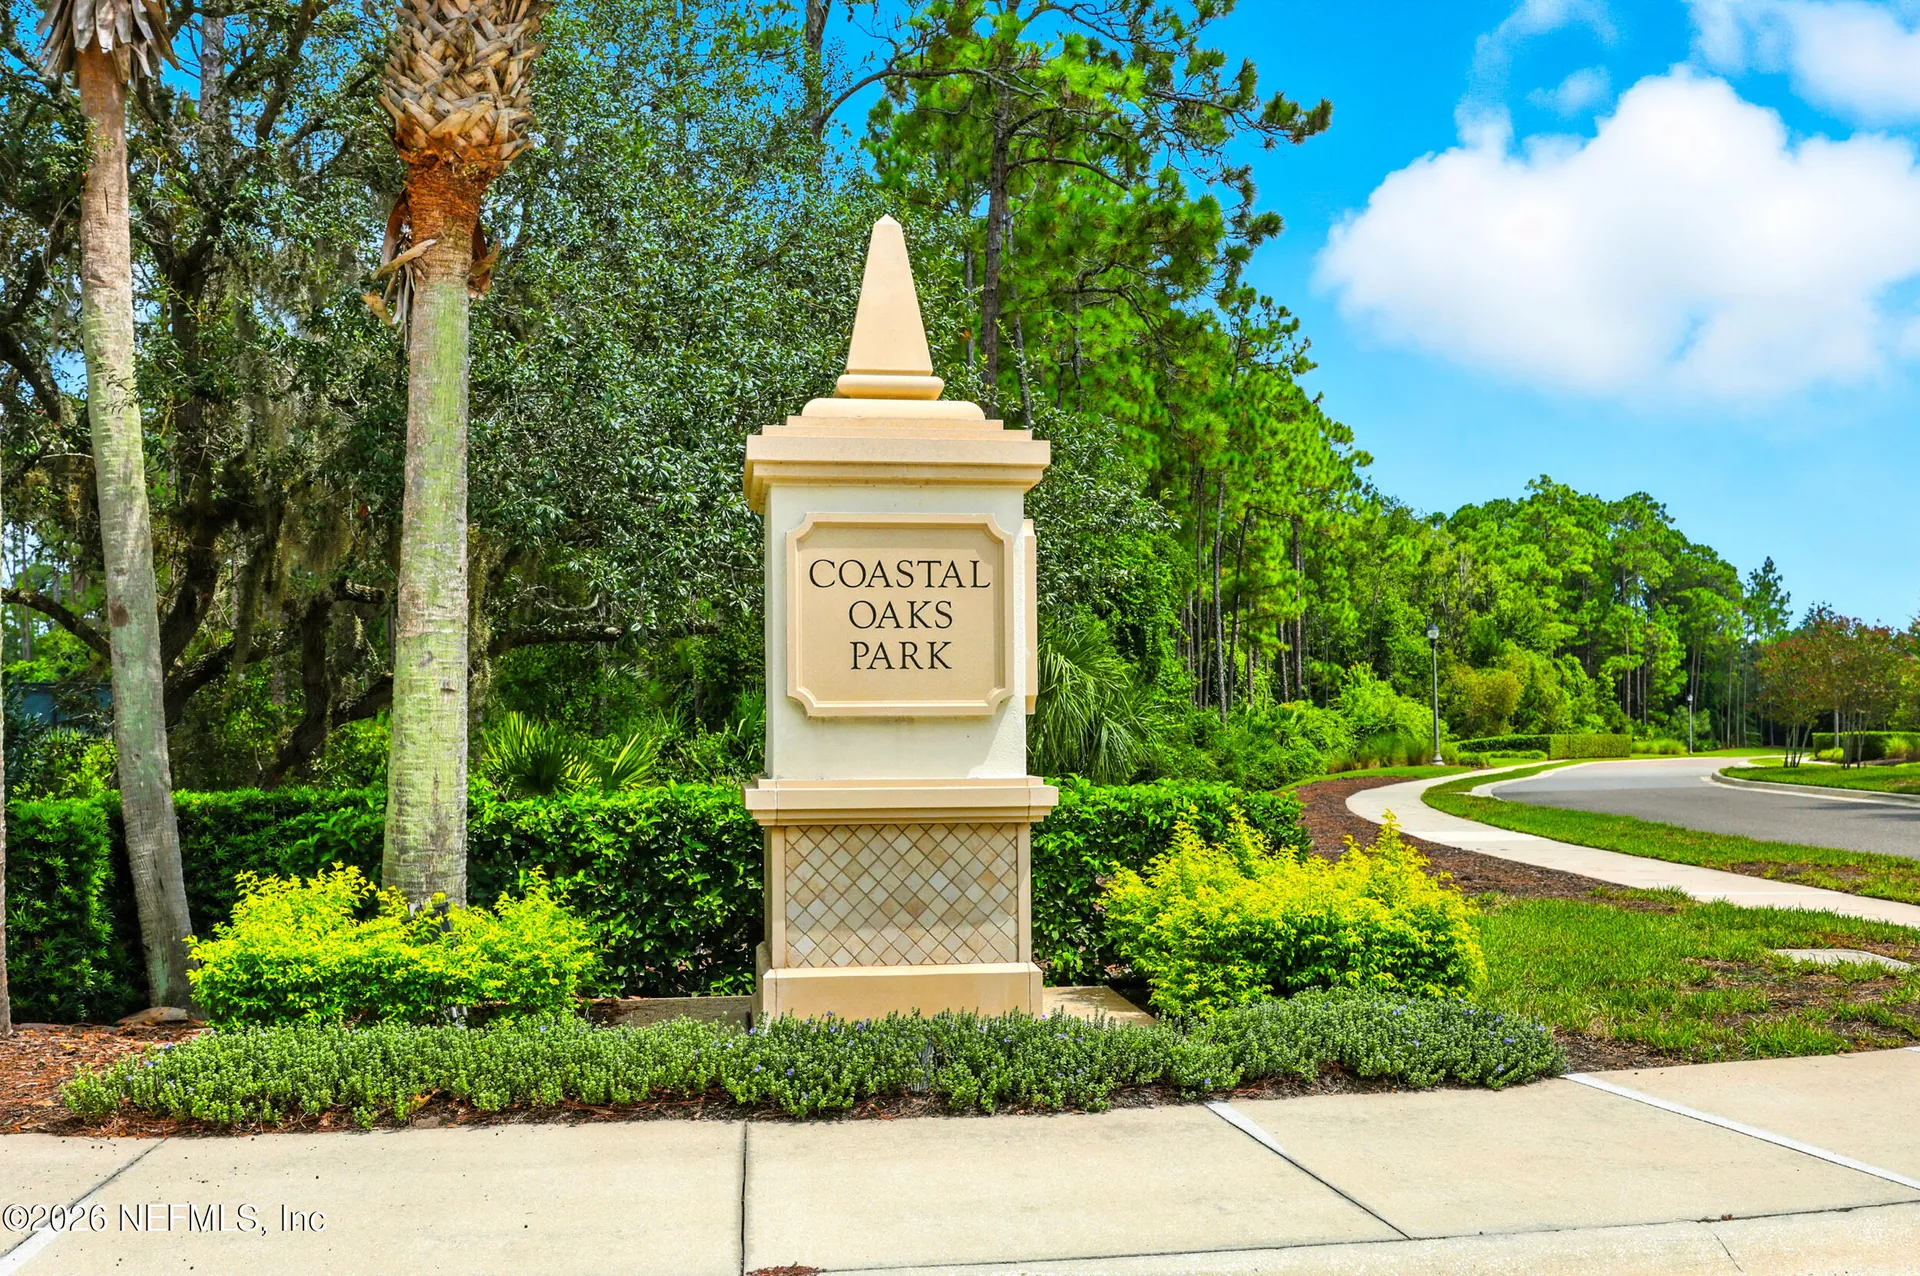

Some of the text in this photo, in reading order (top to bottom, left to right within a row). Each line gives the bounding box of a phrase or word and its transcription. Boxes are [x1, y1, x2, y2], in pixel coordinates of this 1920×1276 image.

[809, 559, 991, 589] COASTAL
[848, 600, 953, 630] OAKS
[849, 641, 952, 670] PARK
